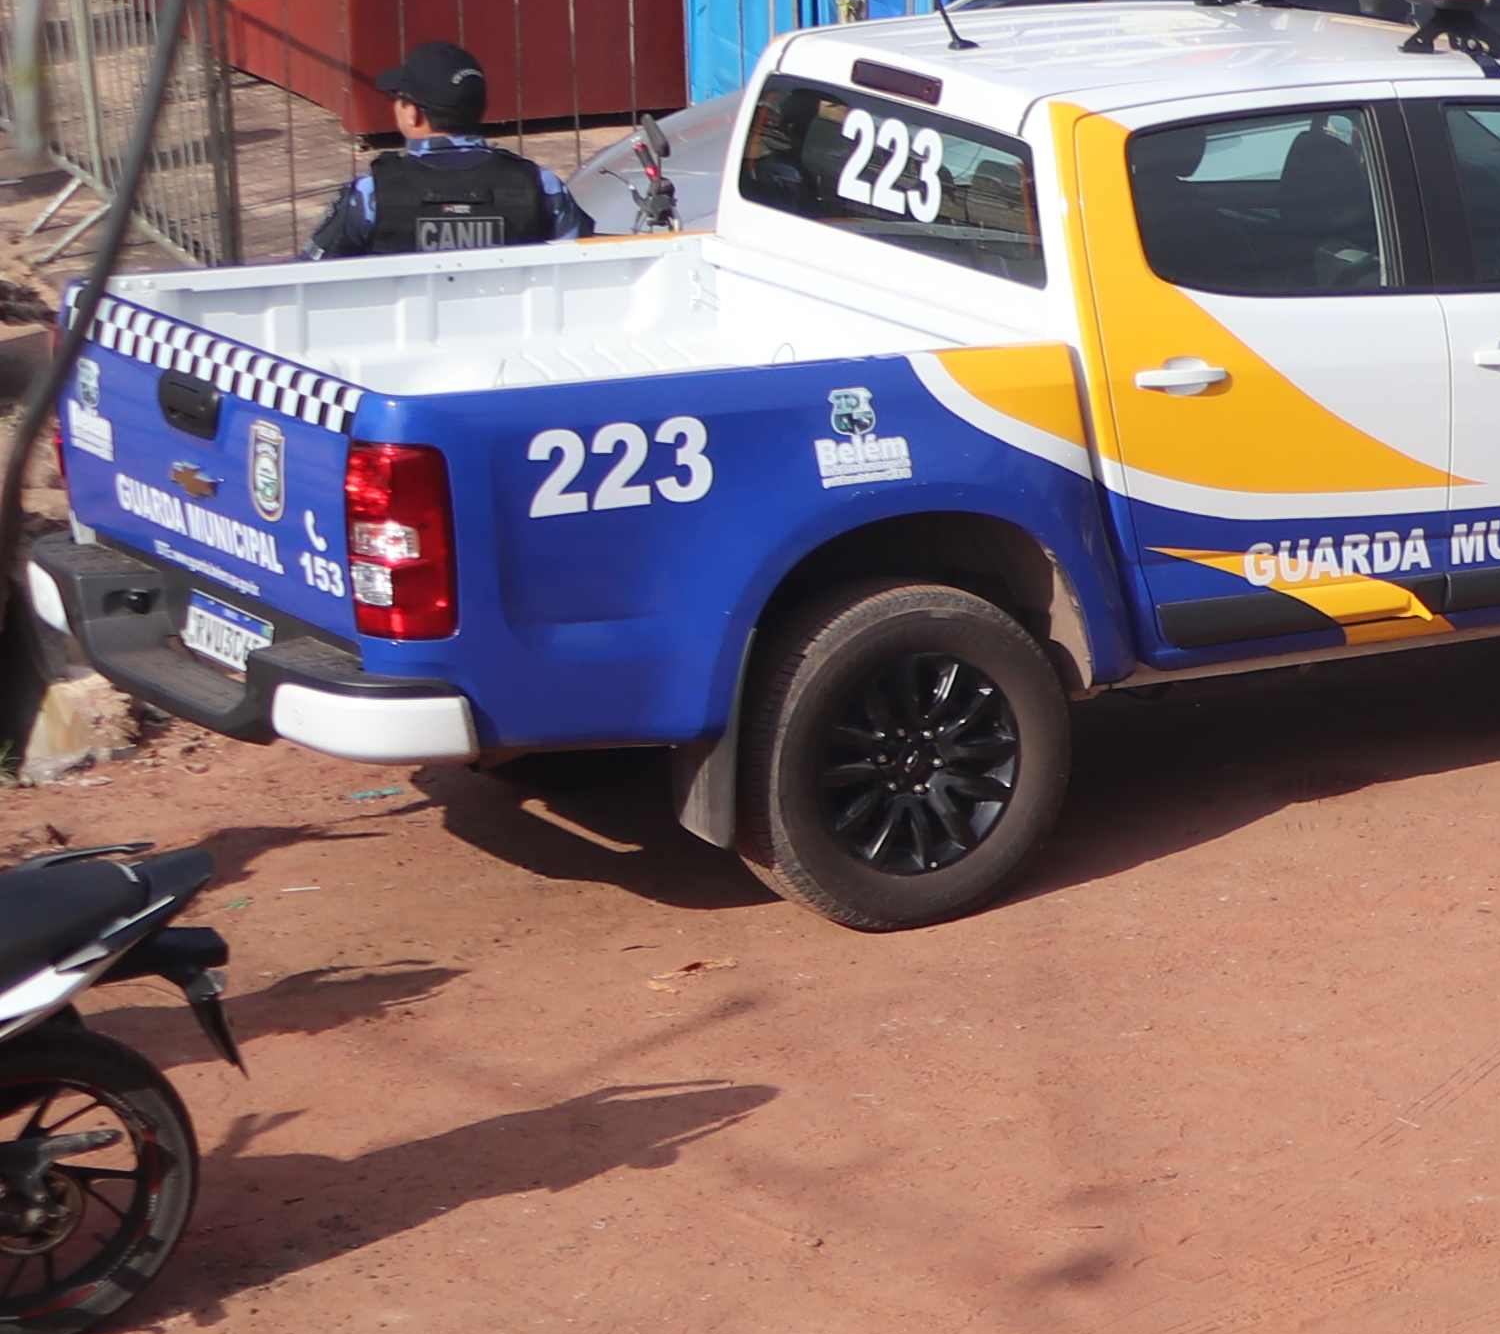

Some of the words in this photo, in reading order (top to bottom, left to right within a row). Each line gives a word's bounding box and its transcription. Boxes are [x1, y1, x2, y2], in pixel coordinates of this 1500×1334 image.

[836, 109, 944, 224] 223
[420, 220, 496, 252] CANIL
[527, 415, 715, 519] 223
[813, 433, 910, 466] Belém
[114, 472, 190, 537] GUARDA
[184, 500, 286, 576] MUNICIPAL
[300, 551, 347, 598] 153
[1242, 527, 1432, 587] GUARDA
